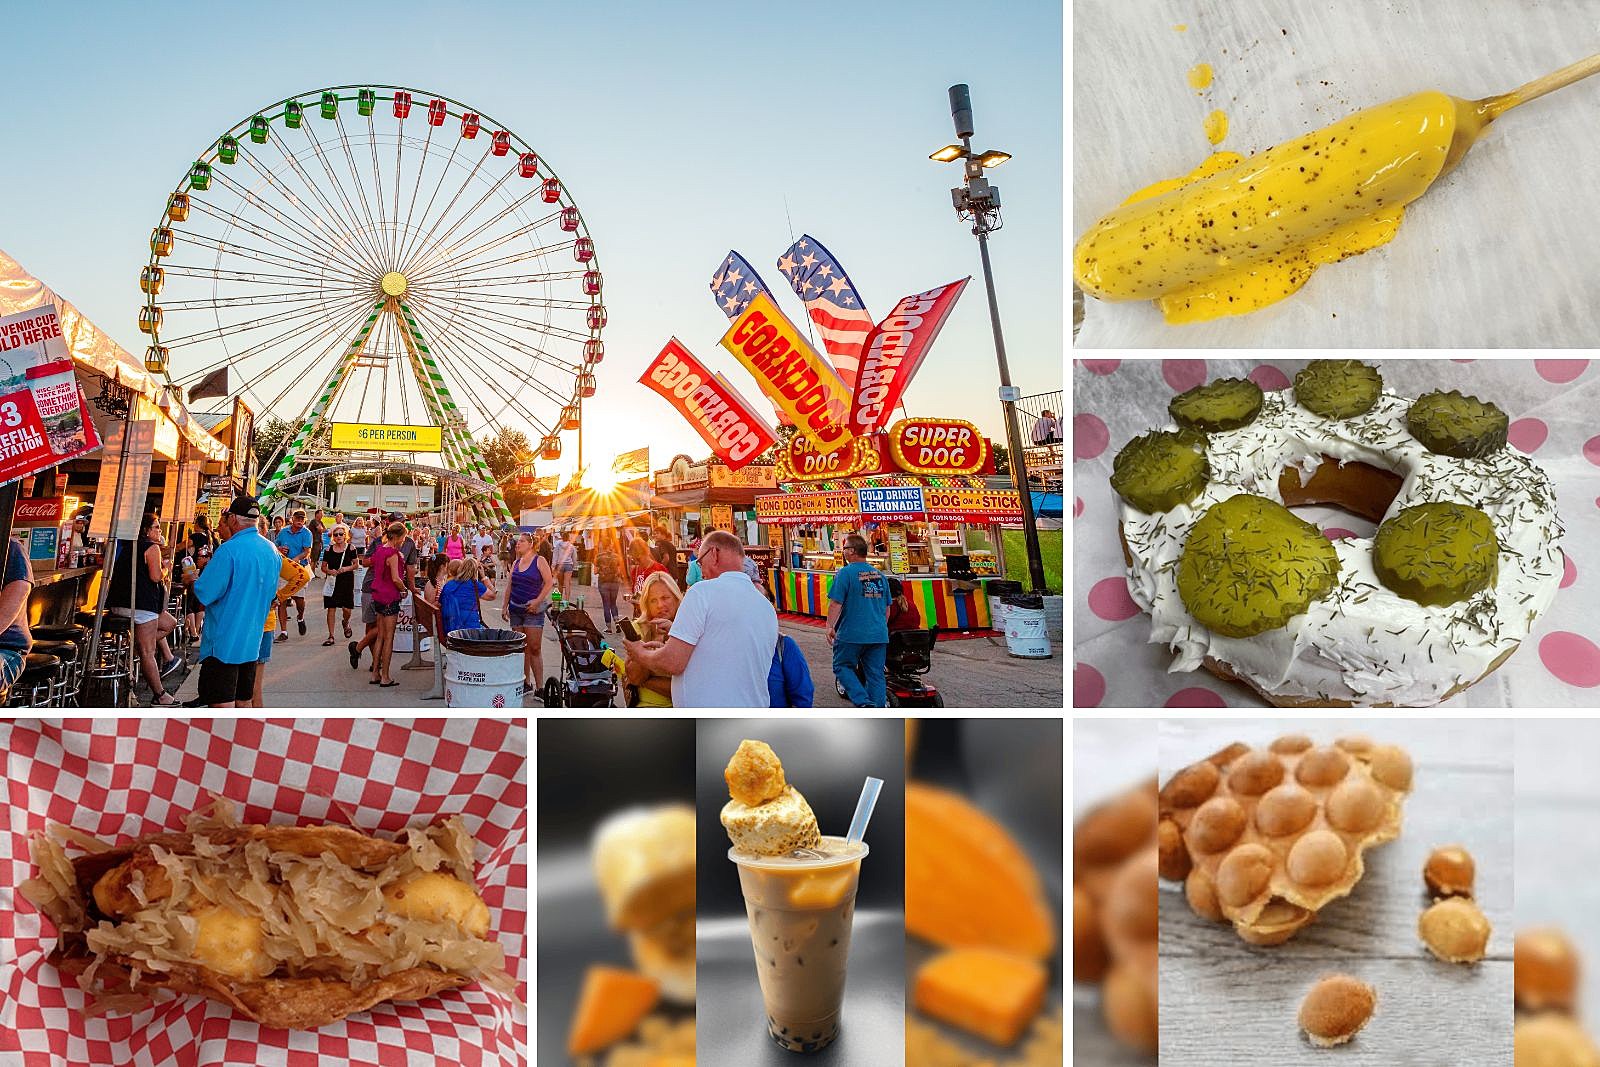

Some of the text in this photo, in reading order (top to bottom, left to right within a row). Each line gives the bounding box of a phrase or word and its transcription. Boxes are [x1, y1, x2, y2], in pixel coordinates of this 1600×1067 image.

[0, 313, 56, 337] VENIR CUP
[0, 323, 61, 352] LD HERE
[0, 401, 22, 426] 3
[0, 425, 40, 449] EFILL
[358, 428, 417, 441] $6 PER PERSON
[904, 426, 971, 448] SUPER
[803, 451, 840, 473] DOG
[918, 447, 966, 466] DOG
[758, 501, 780, 512] LONG
[782, 499, 802, 511] DOG
[816, 500, 822, 508] A
[826, 496, 854, 509] STICK
[860, 489, 919, 501] COLD DRINKS
[931, 494, 961, 507] DOG
[962, 496, 973, 505] ON
[982, 495, 1020, 508] STICK
[862, 500, 921, 513] LEMONADE
